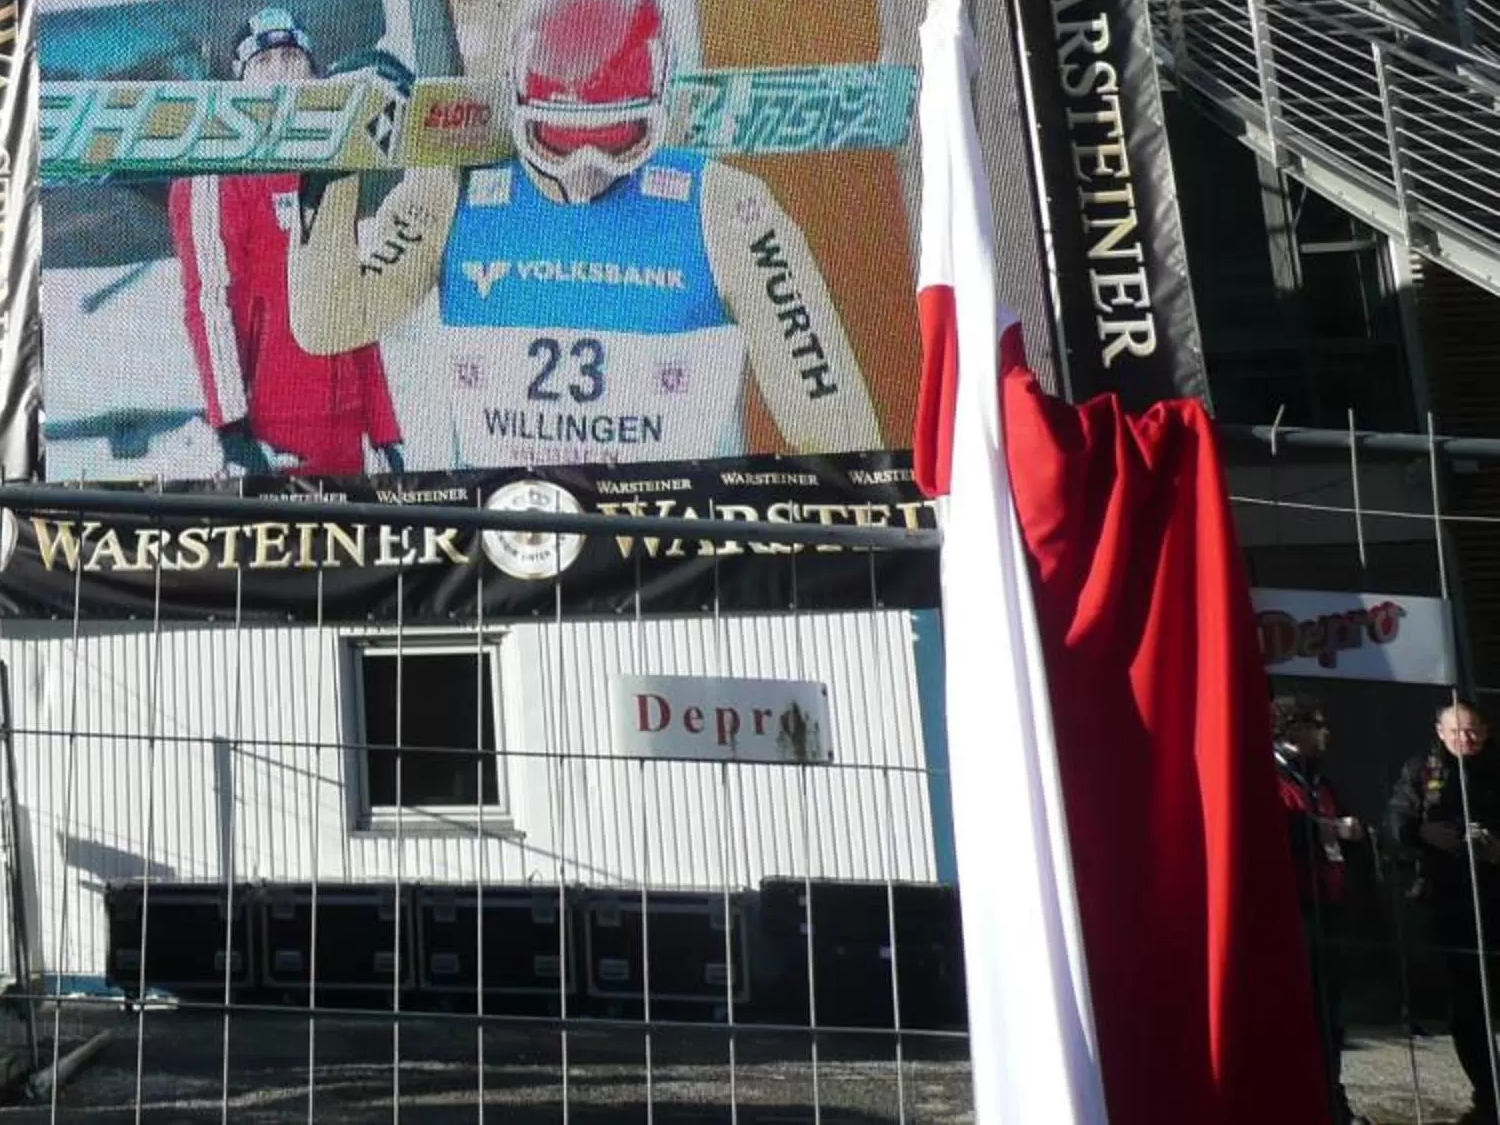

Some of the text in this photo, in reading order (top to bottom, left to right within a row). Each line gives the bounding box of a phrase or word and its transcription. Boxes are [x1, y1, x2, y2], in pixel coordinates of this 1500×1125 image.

[516, 259, 687, 289] VOLKSBANK
[750, 228, 839, 400] WÜRTH
[527, 337, 607, 403] 23
[483, 407, 663, 444] WILLINGEN
[375, 487, 469, 505] WARSTEINER
[595, 469, 916, 494] WARSTEINER WARSTEINER WARSTEI
[31, 517, 470, 573] WARSTEINER
